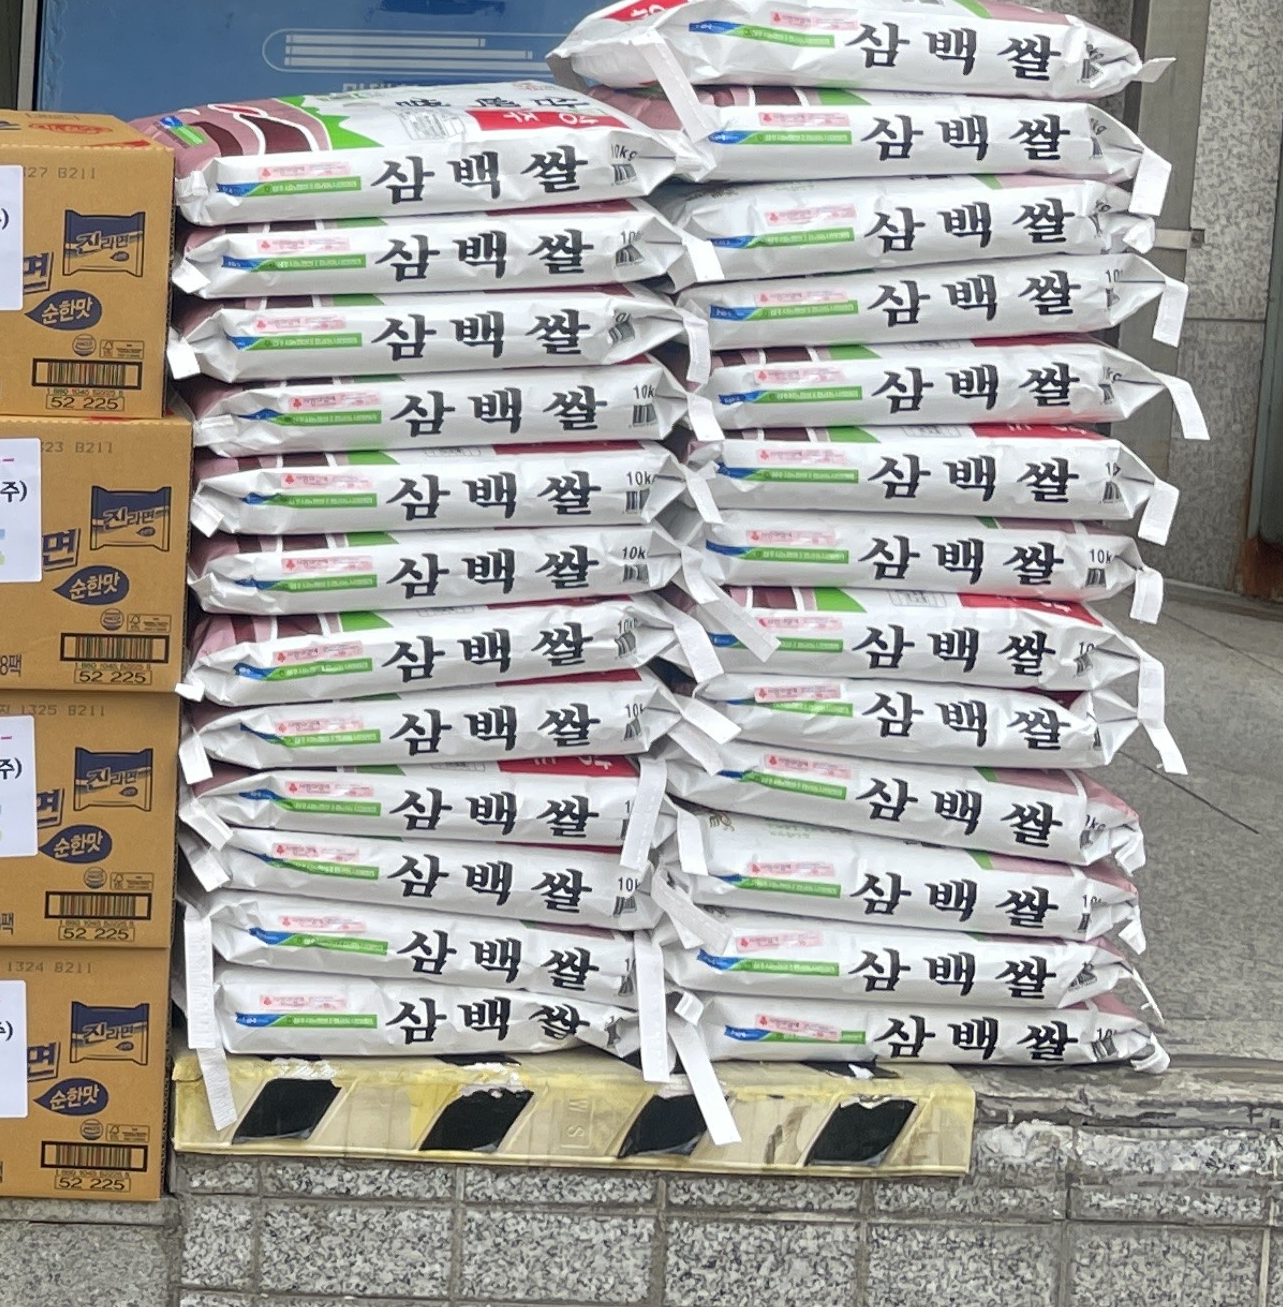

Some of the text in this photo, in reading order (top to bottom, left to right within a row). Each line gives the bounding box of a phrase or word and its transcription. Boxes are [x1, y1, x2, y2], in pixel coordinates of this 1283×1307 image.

[845, 20, 1062, 81] 삼백쌀
[370, 145, 589, 205] 삼백쌀
[863, 198, 1076, 253] 삼백쌀
[372, 308, 591, 361] 삼백쌀
[875, 362, 1085, 414] 삼백쌀
[858, 534, 1065, 586] 삼백쌀
[381, 622, 594, 684] 삼백쌀
[388, 787, 600, 838] 삼백쌀
[849, 871, 1059, 930] 삼백쌀
[396, 929, 600, 993] 삼백쌀
[874, 1014, 1081, 1062] 삼백쌀
[50, 1084, 100, 1111] 순한맛
[59, 1178, 126, 1190] 52 225
